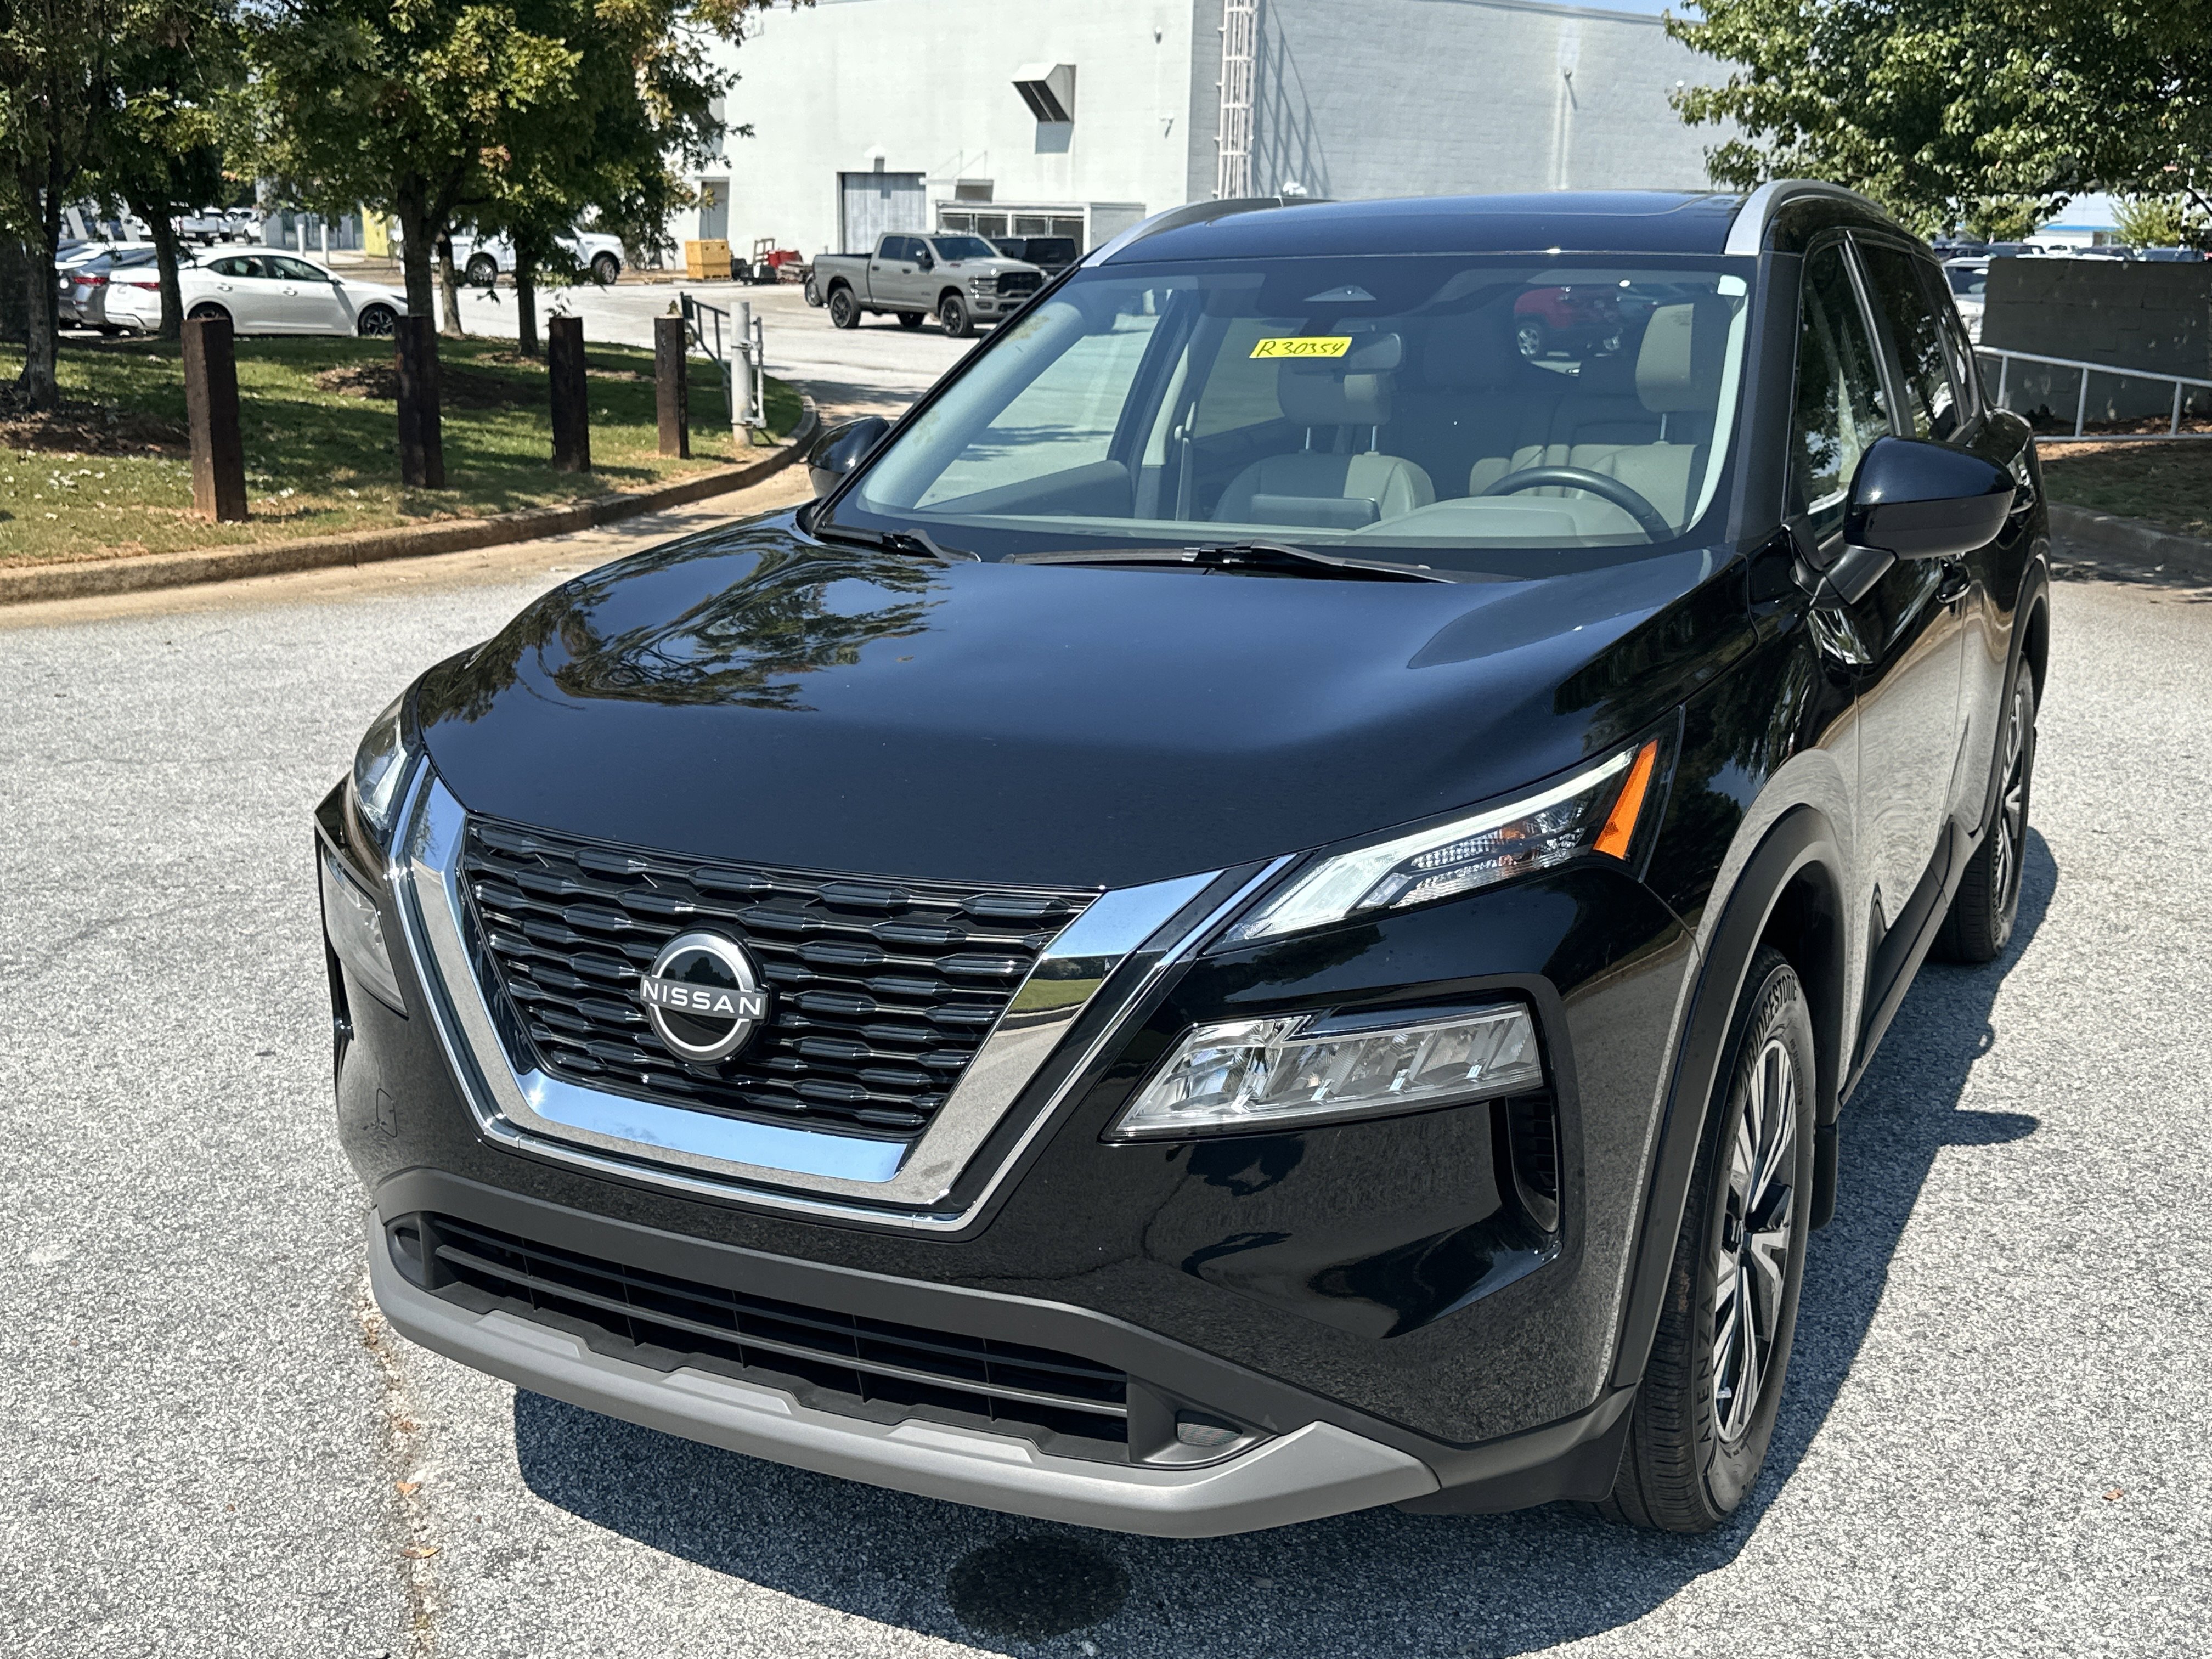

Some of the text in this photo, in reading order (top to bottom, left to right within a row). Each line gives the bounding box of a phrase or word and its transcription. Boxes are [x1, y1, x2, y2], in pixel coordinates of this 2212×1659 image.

[1256, 340, 1345, 358] R 30354
[642, 979, 761, 1016] NISSAN
[1696, 1294, 1713, 1444] ALENZA
